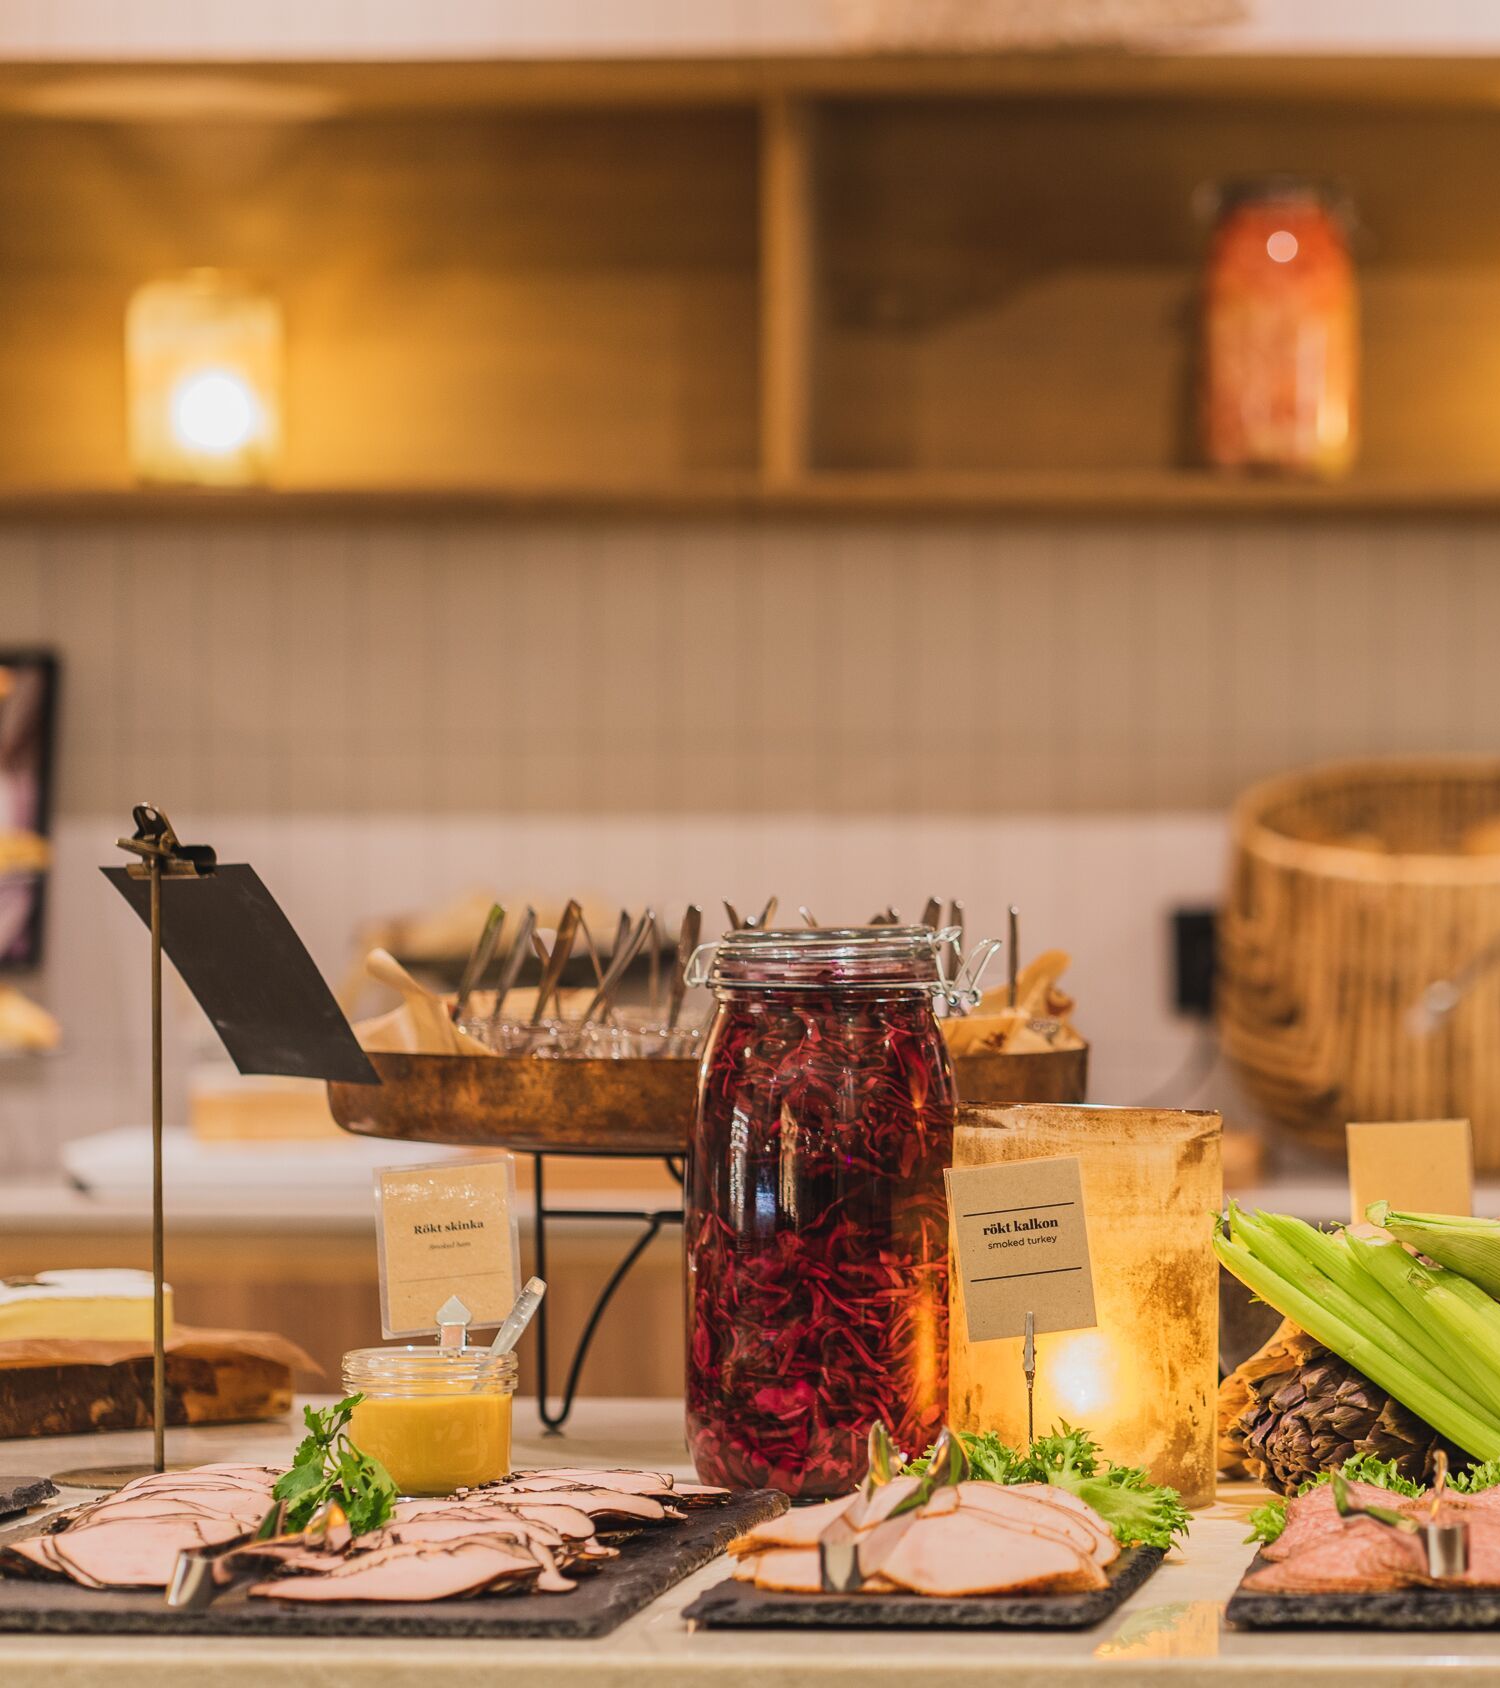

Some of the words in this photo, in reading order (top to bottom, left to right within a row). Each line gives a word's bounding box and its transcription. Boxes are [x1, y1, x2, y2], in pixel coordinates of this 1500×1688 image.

[413, 1223, 442, 1235] Rökt
[445, 1219, 485, 1231] skinka
[982, 1222, 1012, 1236] rökt
[1013, 1218, 1059, 1232] kalkon
[987, 1237, 1025, 1250] smoked
[1027, 1235, 1057, 1246] turkey
